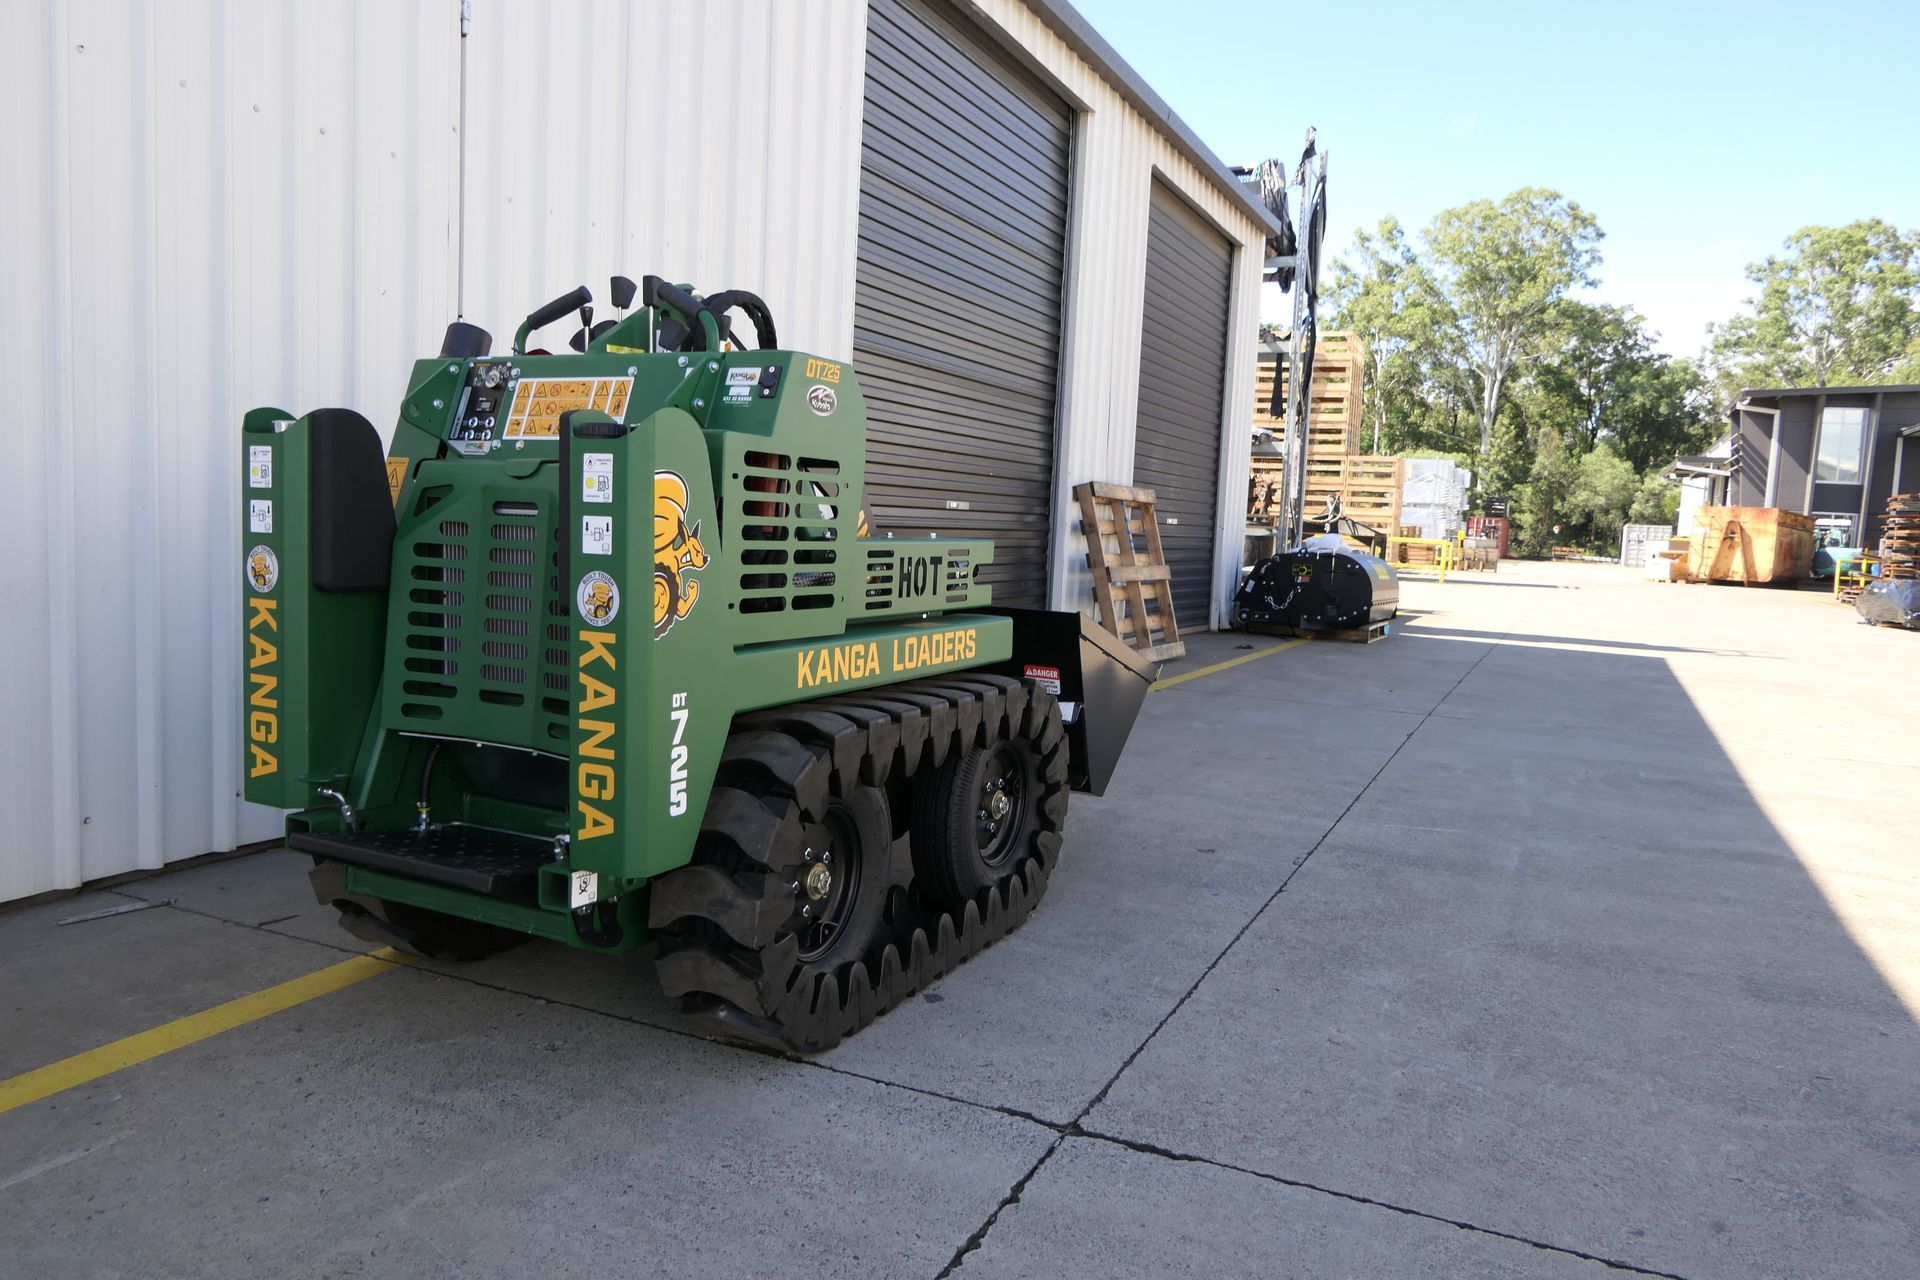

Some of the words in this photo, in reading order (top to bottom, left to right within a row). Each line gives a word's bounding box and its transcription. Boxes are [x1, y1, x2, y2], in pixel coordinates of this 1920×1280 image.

[806, 358, 841, 381] DT725
[582, 572, 596, 585] BUILT
[598, 572, 615, 587] TOUGH
[898, 556, 943, 599] HOT
[584, 613, 600, 626] SINCE
[797, 642, 881, 689] KANGA
[893, 629, 977, 673] LOADERS
[1032, 669, 1058, 679] DANGER
[249, 597, 278, 778] KANGA
[672, 692, 688, 708] DT
[578, 630, 617, 841] KANGA
[669, 708, 690, 818] 725
